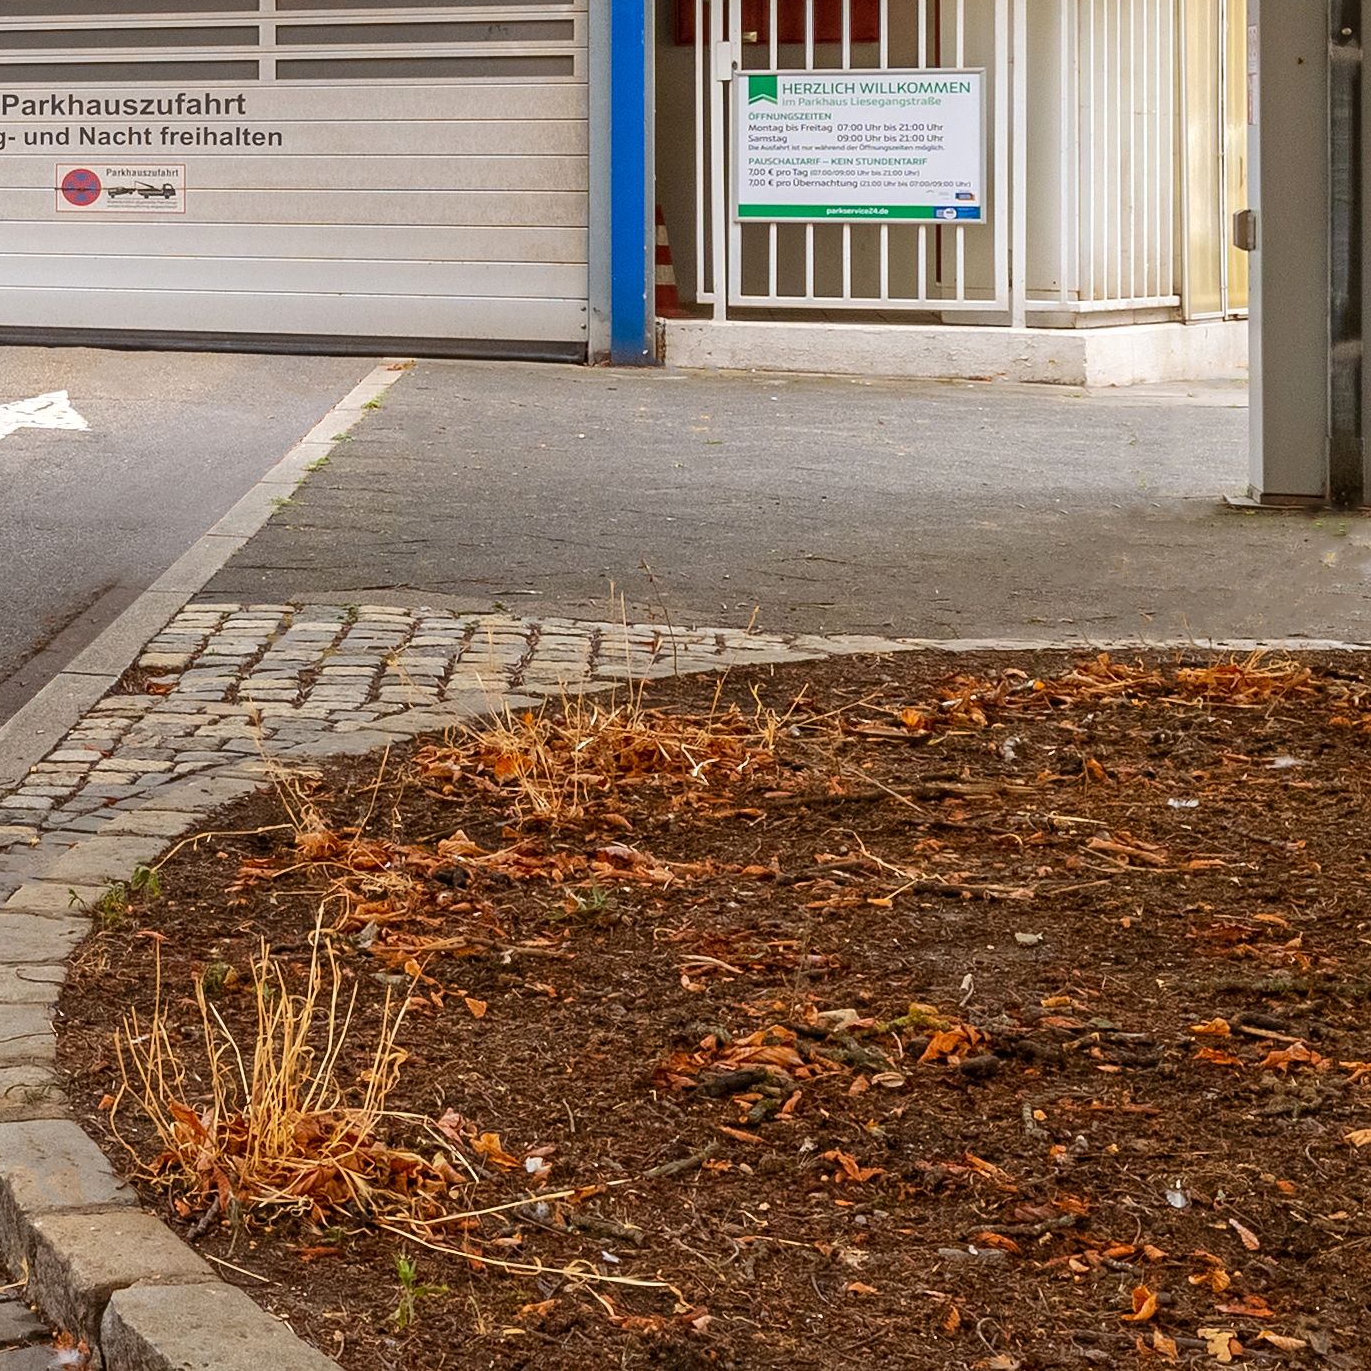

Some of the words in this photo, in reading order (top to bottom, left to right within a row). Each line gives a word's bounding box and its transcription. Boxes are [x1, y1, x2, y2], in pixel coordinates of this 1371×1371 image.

[782, 82, 855, 95] HERZLICH
[859, 81, 971, 94] WILLKOMMEN
[1, 93, 246, 116] Parkhauszufahrt
[798, 97, 848, 107] Parkhaus
[850, 96, 942, 108] Liesegangstraße
[748, 112, 832, 121] ÖFFNUNGSZEITEN
[748, 124, 783, 133] Montag
[786, 123, 799, 132] bis
[801, 123, 833, 133] Freitag
[837, 124, 863, 132] 07:00
[865, 124, 881, 132] Uhr
[883, 124, 897, 132] bis
[899, 124, 925, 132] 21:00
[927, 124, 943, 132] Uhr
[24, 127, 70, 146] und
[79, 127, 152, 146] Nacht
[160, 126, 283, 146] freihalten
[748, 134, 788, 143] Samstag
[837, 134, 863, 142] 09:00
[865, 134, 881, 142] Uhr
[883, 134, 897, 142] bis
[899, 134, 925, 142] 21:00
[927, 134, 943, 142] Uhr
[748, 157, 820, 165] PAUSCHALTARIF
[830, 157, 854, 165] KEIN
[855, 157, 928, 166] STUNDENTARIF
[106, 168, 179, 176] Parkhauszufahrt
[768, 168, 774, 176] €
[776, 170, 791, 178] pro
[793, 168, 808, 178] Tag
[904, 169, 920, 177] Uhr)
[768, 179, 774, 187] €
[793, 178, 858, 189] Übernachtung
[826, 207, 889, 216] parkservice24.de
